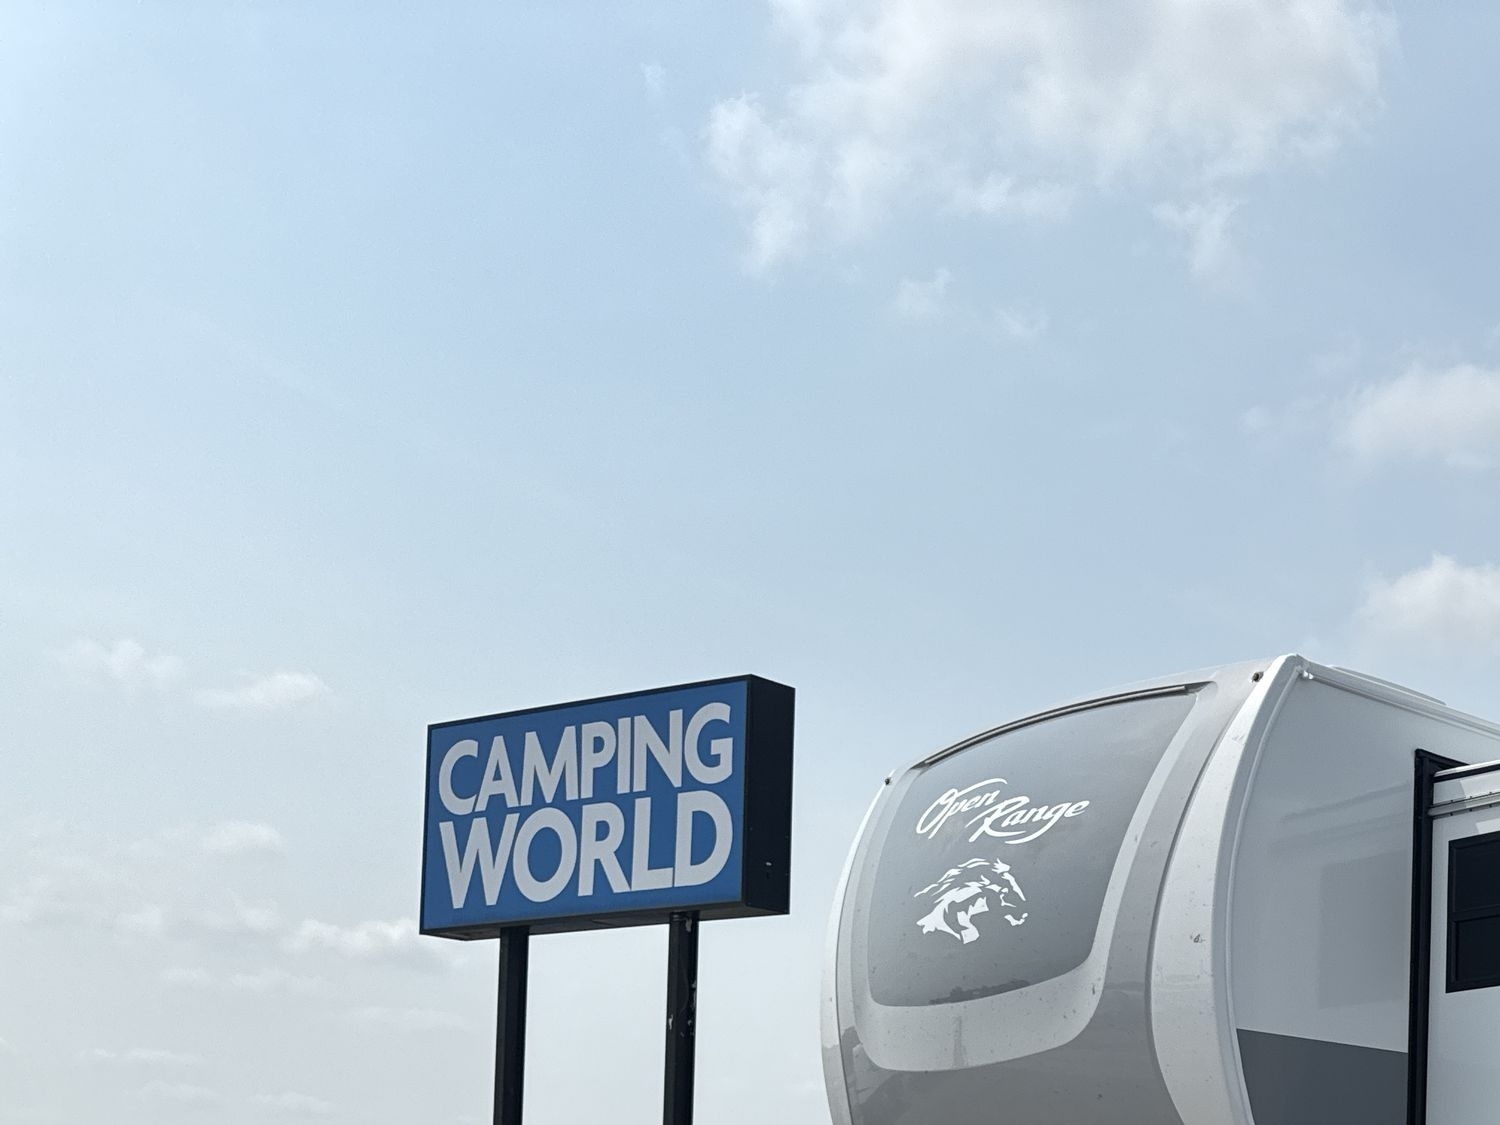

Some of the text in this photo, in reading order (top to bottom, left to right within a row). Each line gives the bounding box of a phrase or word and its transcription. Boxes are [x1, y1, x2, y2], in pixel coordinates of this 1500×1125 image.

[438, 701, 734, 816] CAMPING
[438, 789, 734, 910] WORLD
[916, 777, 1008, 840] Open
[964, 795, 1091, 845] Range
